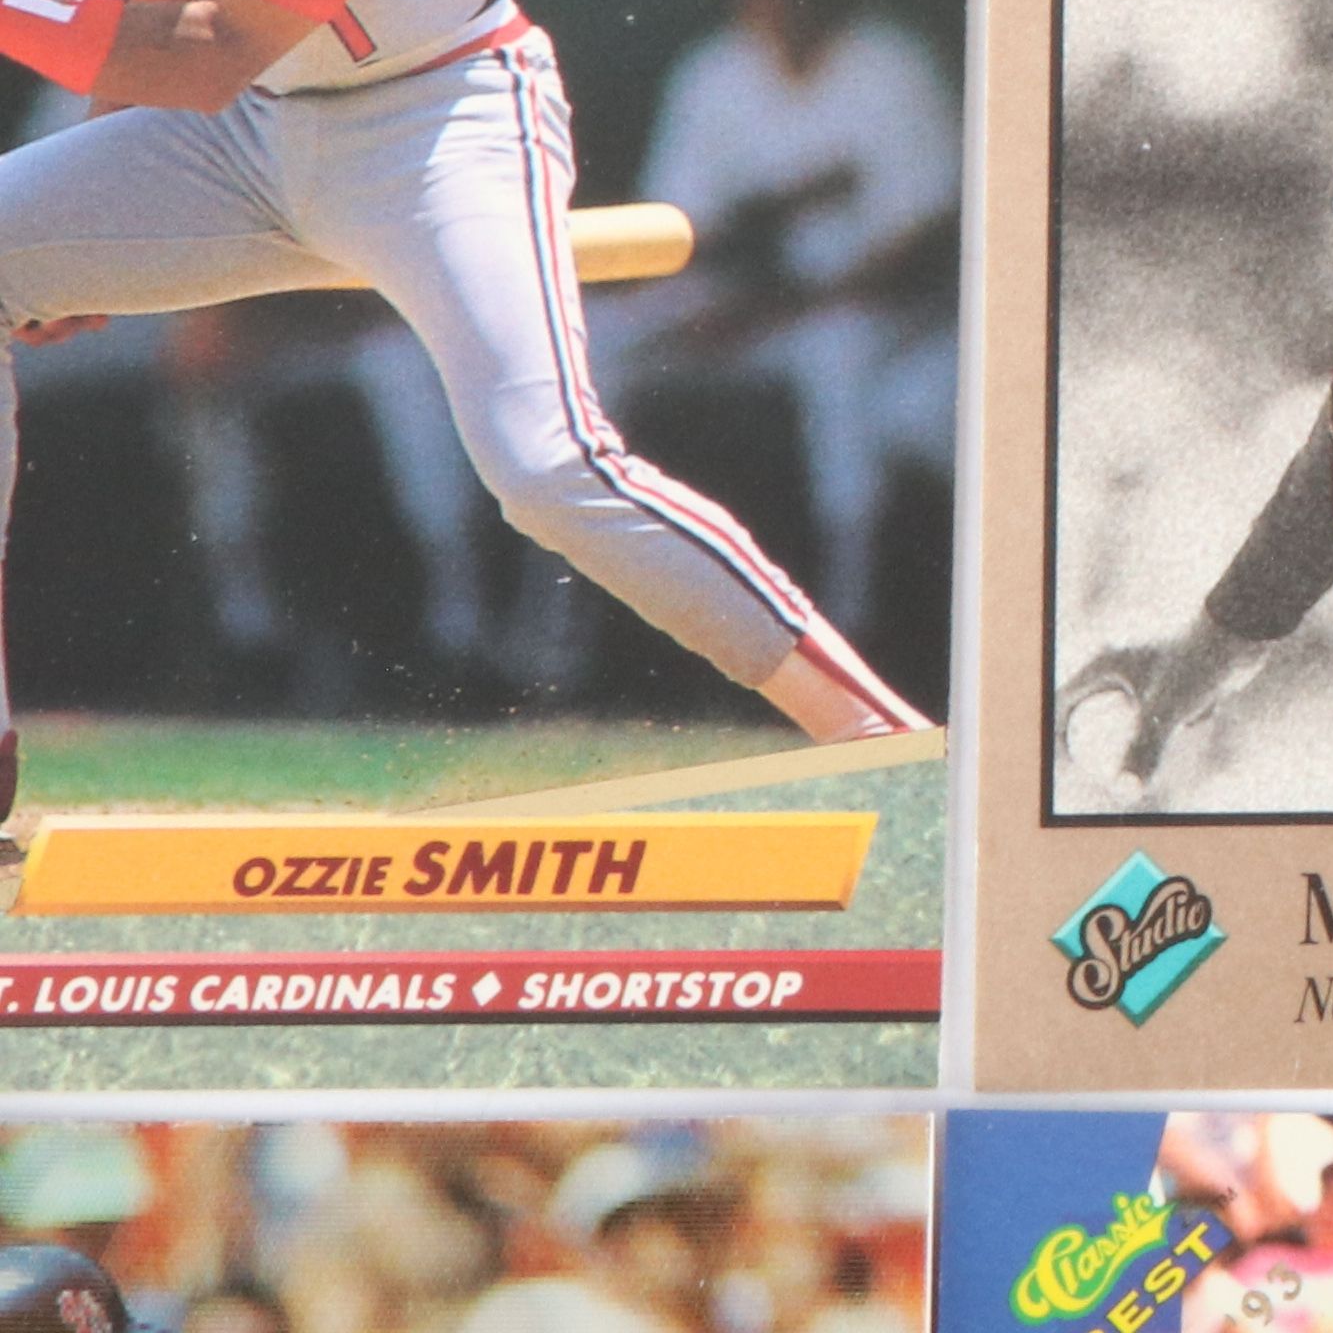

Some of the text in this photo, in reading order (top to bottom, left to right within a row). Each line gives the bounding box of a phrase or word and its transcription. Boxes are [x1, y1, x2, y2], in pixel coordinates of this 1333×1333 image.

[233, 839, 648, 897] OZZIE SMITH
[34, 974, 180, 1014] LOUIS
[189, 971, 456, 1014] CARDINALS
[518, 970, 804, 1011] SHORTSTOP
[1066, 873, 1213, 1011] Studio
[1012, 1192, 1178, 1321] Classic
[1086, 1221, 1214, 1333] EST
